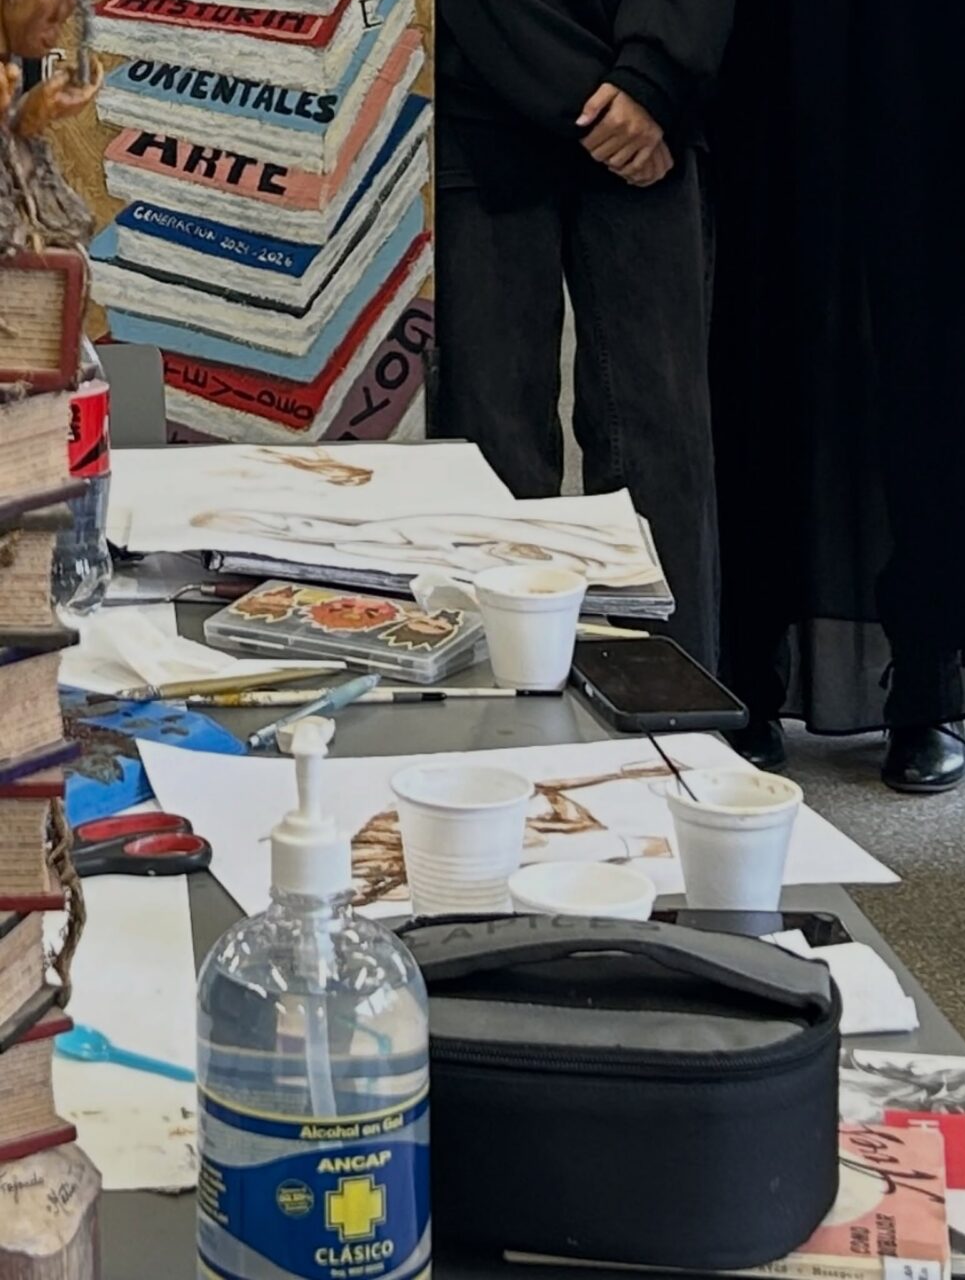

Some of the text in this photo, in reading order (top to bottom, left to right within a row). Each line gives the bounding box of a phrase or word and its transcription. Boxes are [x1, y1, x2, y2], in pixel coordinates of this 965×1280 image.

[126, 59, 339, 123] ORIENTALES
[128, 131, 288, 195] ARTE
[338, 307, 433, 441] GOY
[300, 1113, 405, 1139] Alcohol en Gel
[317, 1149, 392, 1174] ANCAP
